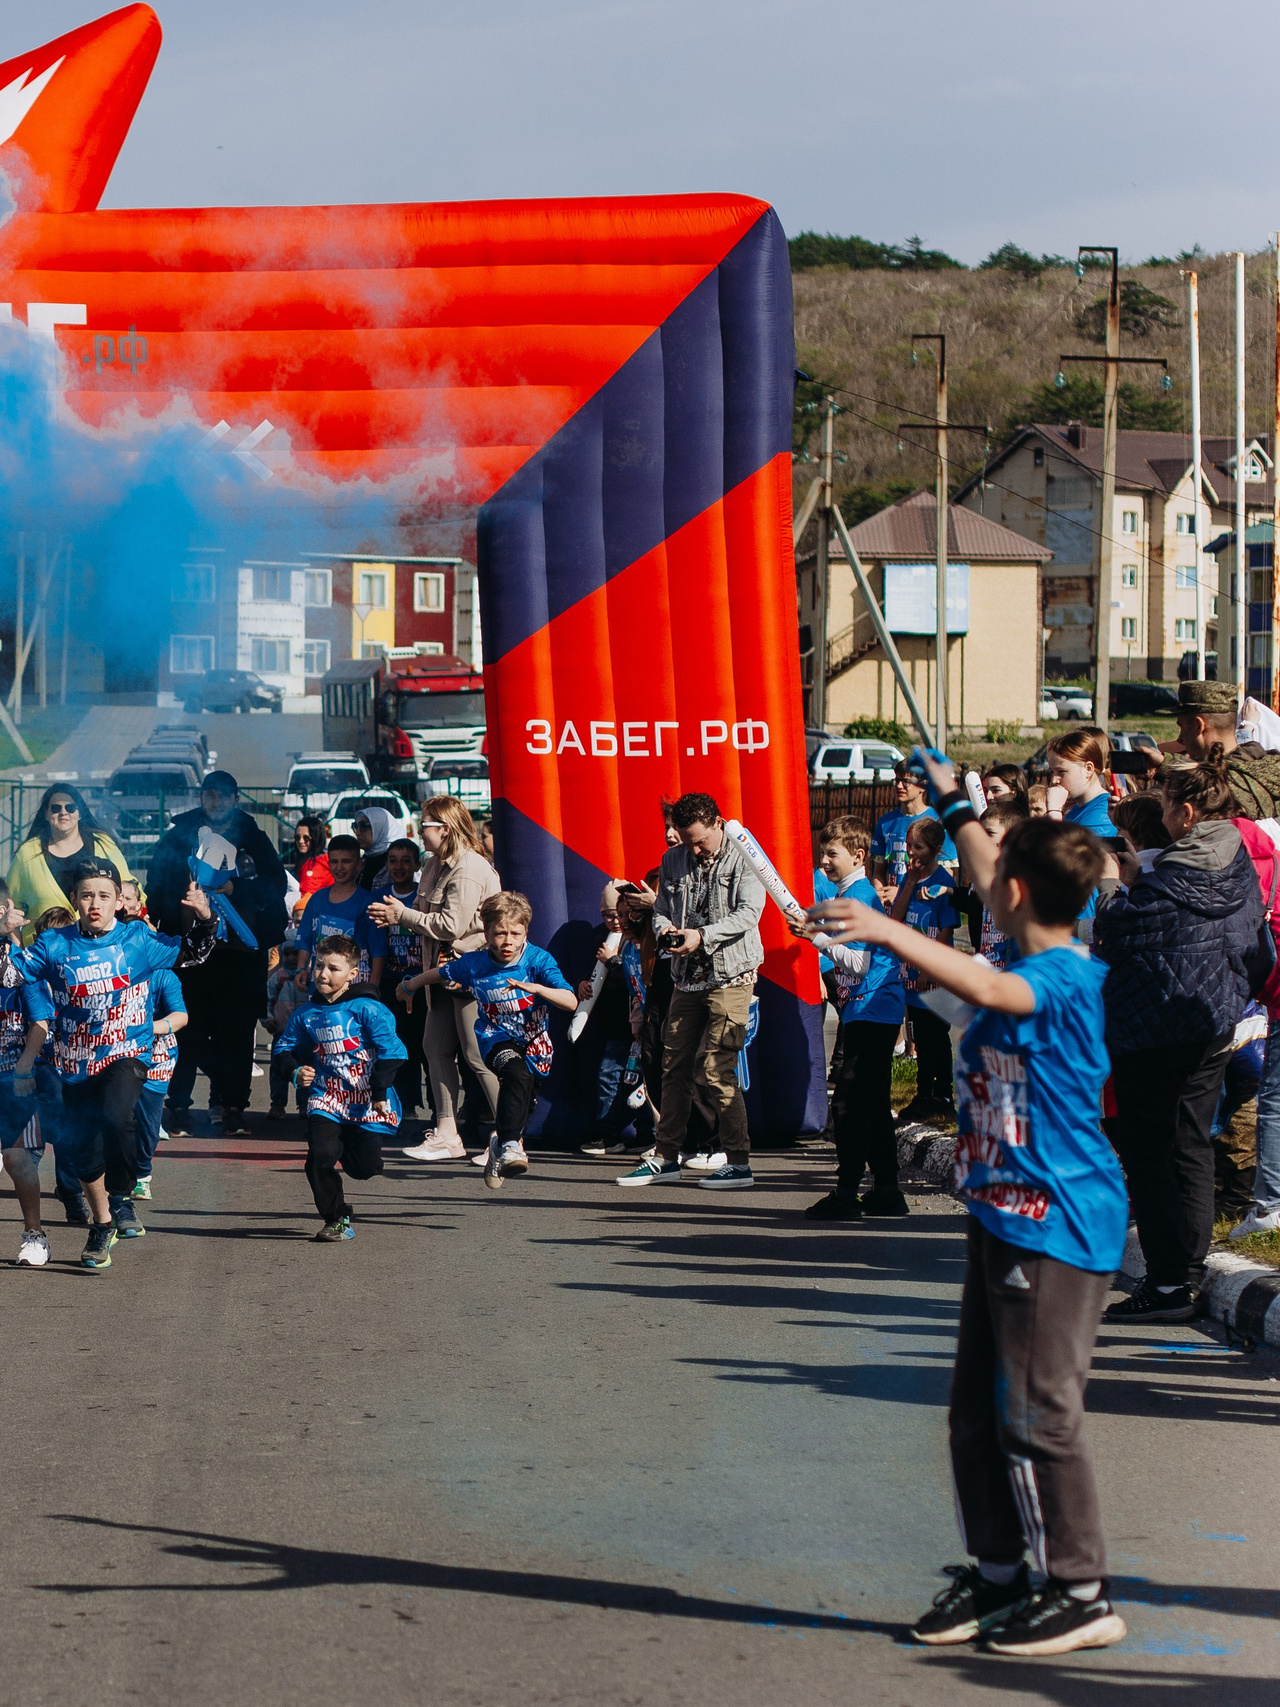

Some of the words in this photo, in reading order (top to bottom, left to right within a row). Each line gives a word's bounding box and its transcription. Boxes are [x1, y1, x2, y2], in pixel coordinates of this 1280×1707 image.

[525, 718, 770, 757] ЗАБЕГ.РФ
[744, 841, 757, 859] ПСБ
[76, 961, 114, 983] 00512
[316, 1024, 345, 1042] 00518
